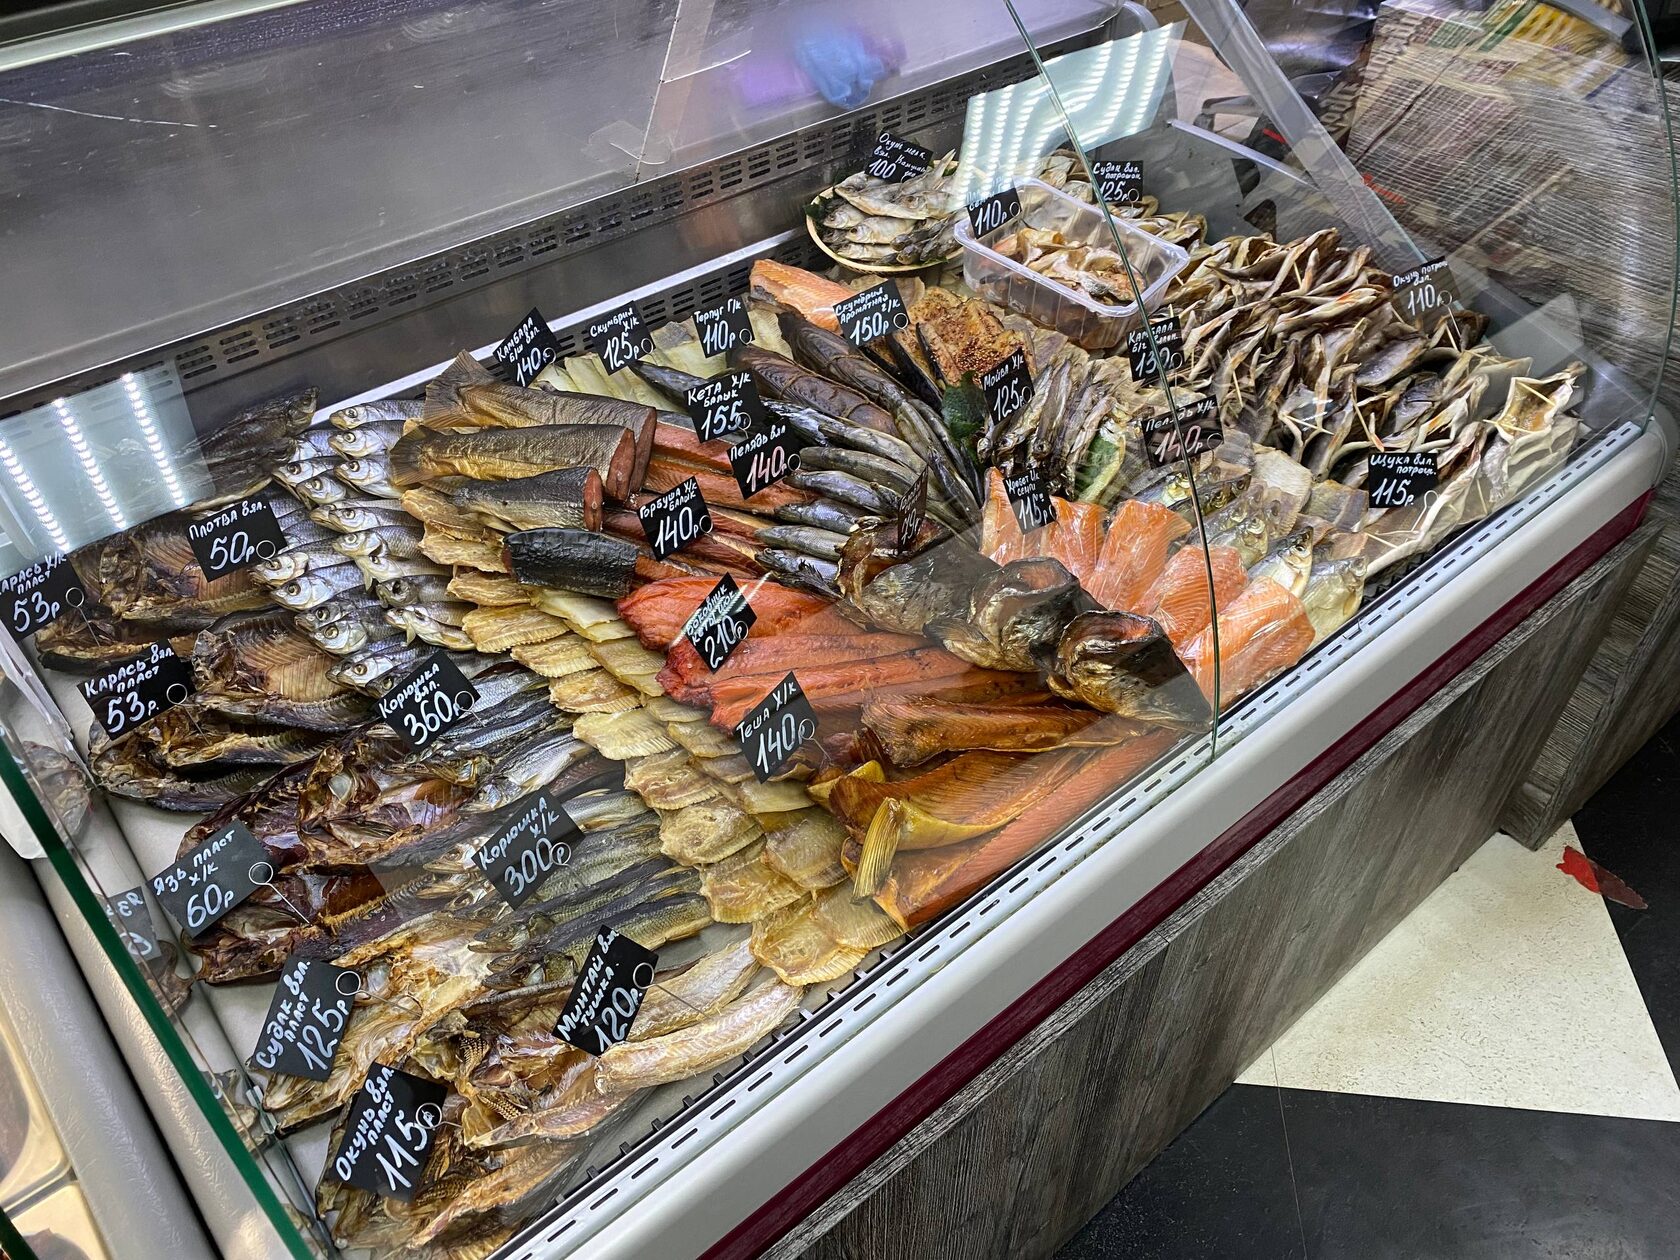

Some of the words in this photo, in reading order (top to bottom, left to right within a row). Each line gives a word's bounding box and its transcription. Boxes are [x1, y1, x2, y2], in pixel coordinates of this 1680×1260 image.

[869, 158, 897, 178] 100
[703, 320, 736, 354] 110р
[850, 311, 889, 345] 150р
[604, 331, 640, 370] 125р
[1371, 478, 1415, 507] 115р.
[654, 506, 699, 555] 140р
[209, 531, 256, 570] 50р
[0, 563, 42, 596] АРАСЬ
[13, 591, 60, 632] 53р
[107, 691, 160, 733] 53р.
[186, 883, 235, 928] 60р
[297, 998, 349, 1070] 125р
